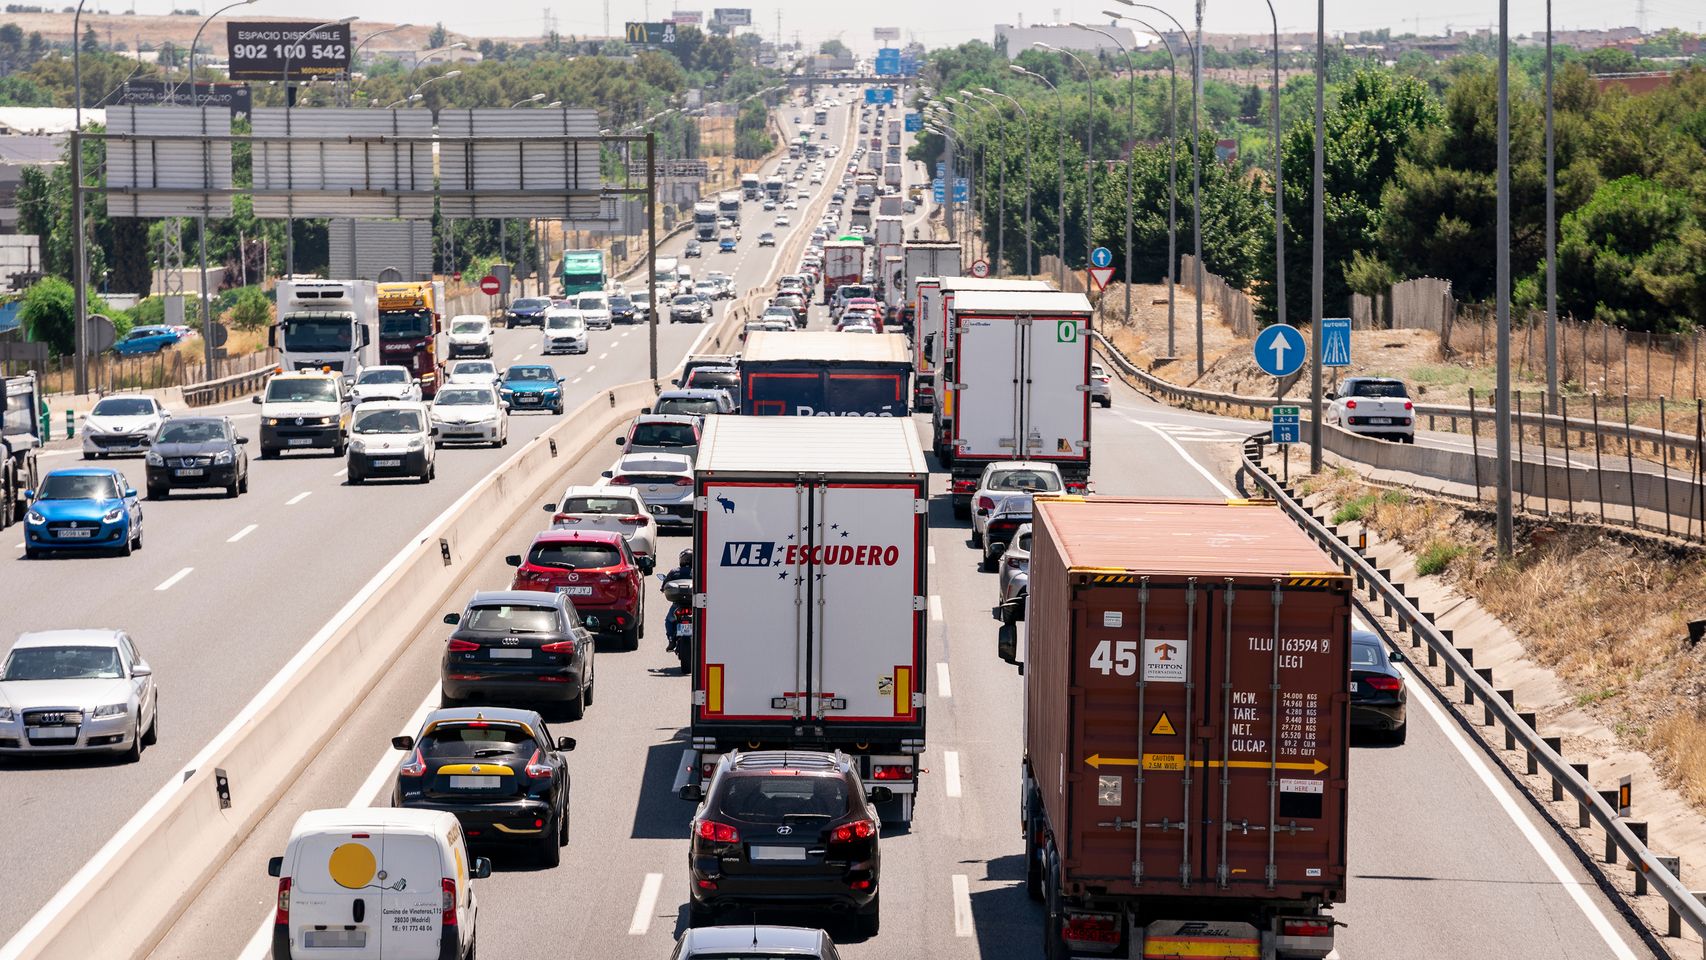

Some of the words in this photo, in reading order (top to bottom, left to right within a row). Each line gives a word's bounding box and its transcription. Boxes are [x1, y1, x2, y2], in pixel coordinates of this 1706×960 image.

[238, 31, 280, 41] ESPACIO
[283, 31, 341, 41] DISPONIBLE
[234, 44, 267, 59] 902
[273, 44, 306, 59] 100
[312, 45, 345, 59] 542
[1281, 433, 1292, 441] 18
[729, 543, 769, 566] V.E.
[785, 545, 899, 566] ESCUDERO
[1249, 638, 1273, 651] TLLU
[1281, 639, 1317, 652] 163594
[1322, 640, 1330, 653] 9
[1090, 640, 1137, 676] 45
[1279, 655, 1303, 668] LEG1
[1233, 692, 1258, 704] MGW.
[1282, 700, 1303, 708] 74.960
[1233, 708, 1260, 721] TARE.
[1232, 724, 1253, 736] NET.
[1231, 740, 1267, 753] CU.CAP.
